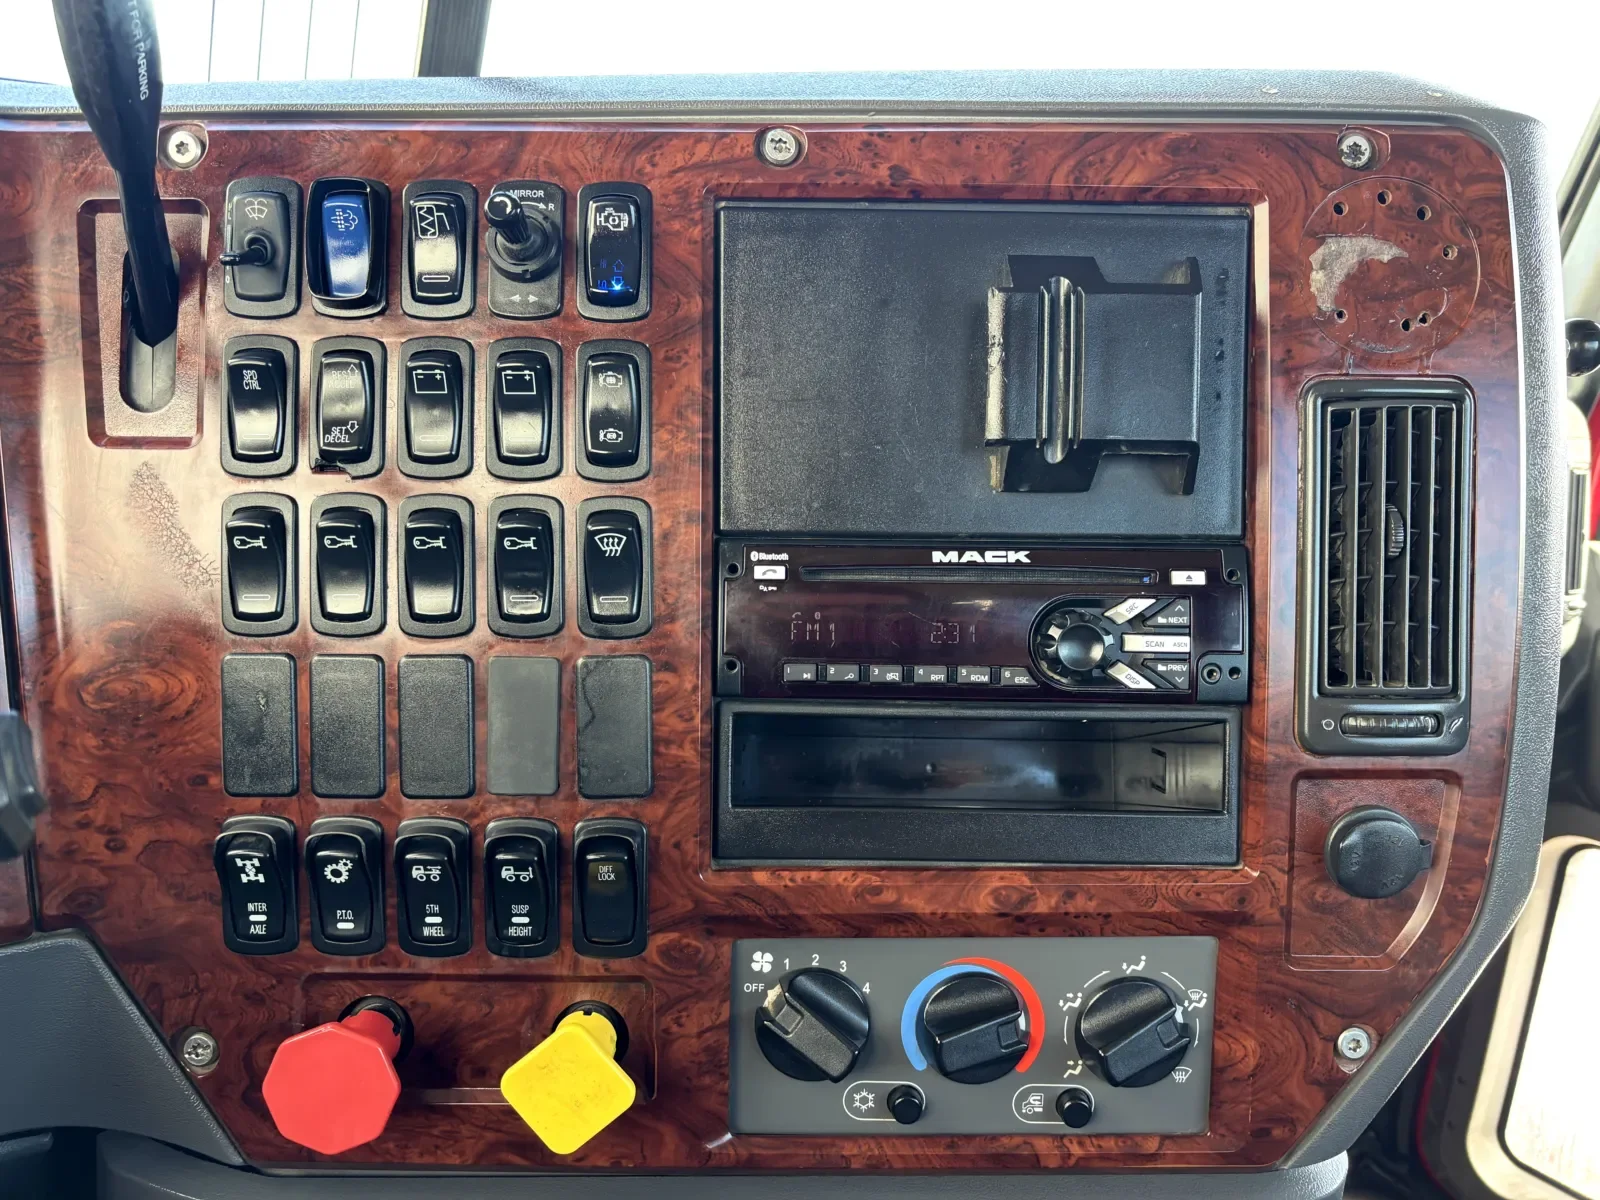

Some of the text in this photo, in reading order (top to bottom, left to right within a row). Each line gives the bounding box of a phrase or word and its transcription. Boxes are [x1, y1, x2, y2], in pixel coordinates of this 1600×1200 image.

[129, 9, 143, 41] FOR
[134, 41, 149, 101] PARKING
[509, 189, 545, 198] MIRROR
[548, 203, 555, 211] R
[242, 369, 258, 380] SPD
[243, 380, 262, 390] CTRL
[331, 426, 347, 435] SET
[324, 434, 351, 443] DECEL
[758, 552, 789, 561] Bluetooth
[931, 550, 1032, 563] MACK
[1125, 602, 1140, 615] SRC
[1168, 616, 1188, 624] NEXT
[1145, 640, 1165, 648] SCAN
[1167, 664, 1188, 672] PREV
[930, 674, 945, 682] RPT
[1124, 673, 1141, 686] DISP
[598, 865, 613, 873] DIFF
[597, 872, 616, 881] LOCK
[247, 902, 267, 912] INTER
[425, 904, 440, 914] 5TH
[511, 904, 530, 914] SUSP
[336, 909, 354, 920] P.T.O.
[249, 924, 267, 935] AXLE
[422, 926, 445, 937] WHEEL
[508, 926, 533, 937] HEIGHT
[783, 958, 790, 971] 1
[811, 953, 820, 966] 2
[839, 960, 847, 972] 3
[743, 983, 765, 993] OFF
[862, 982, 871, 994] 4
